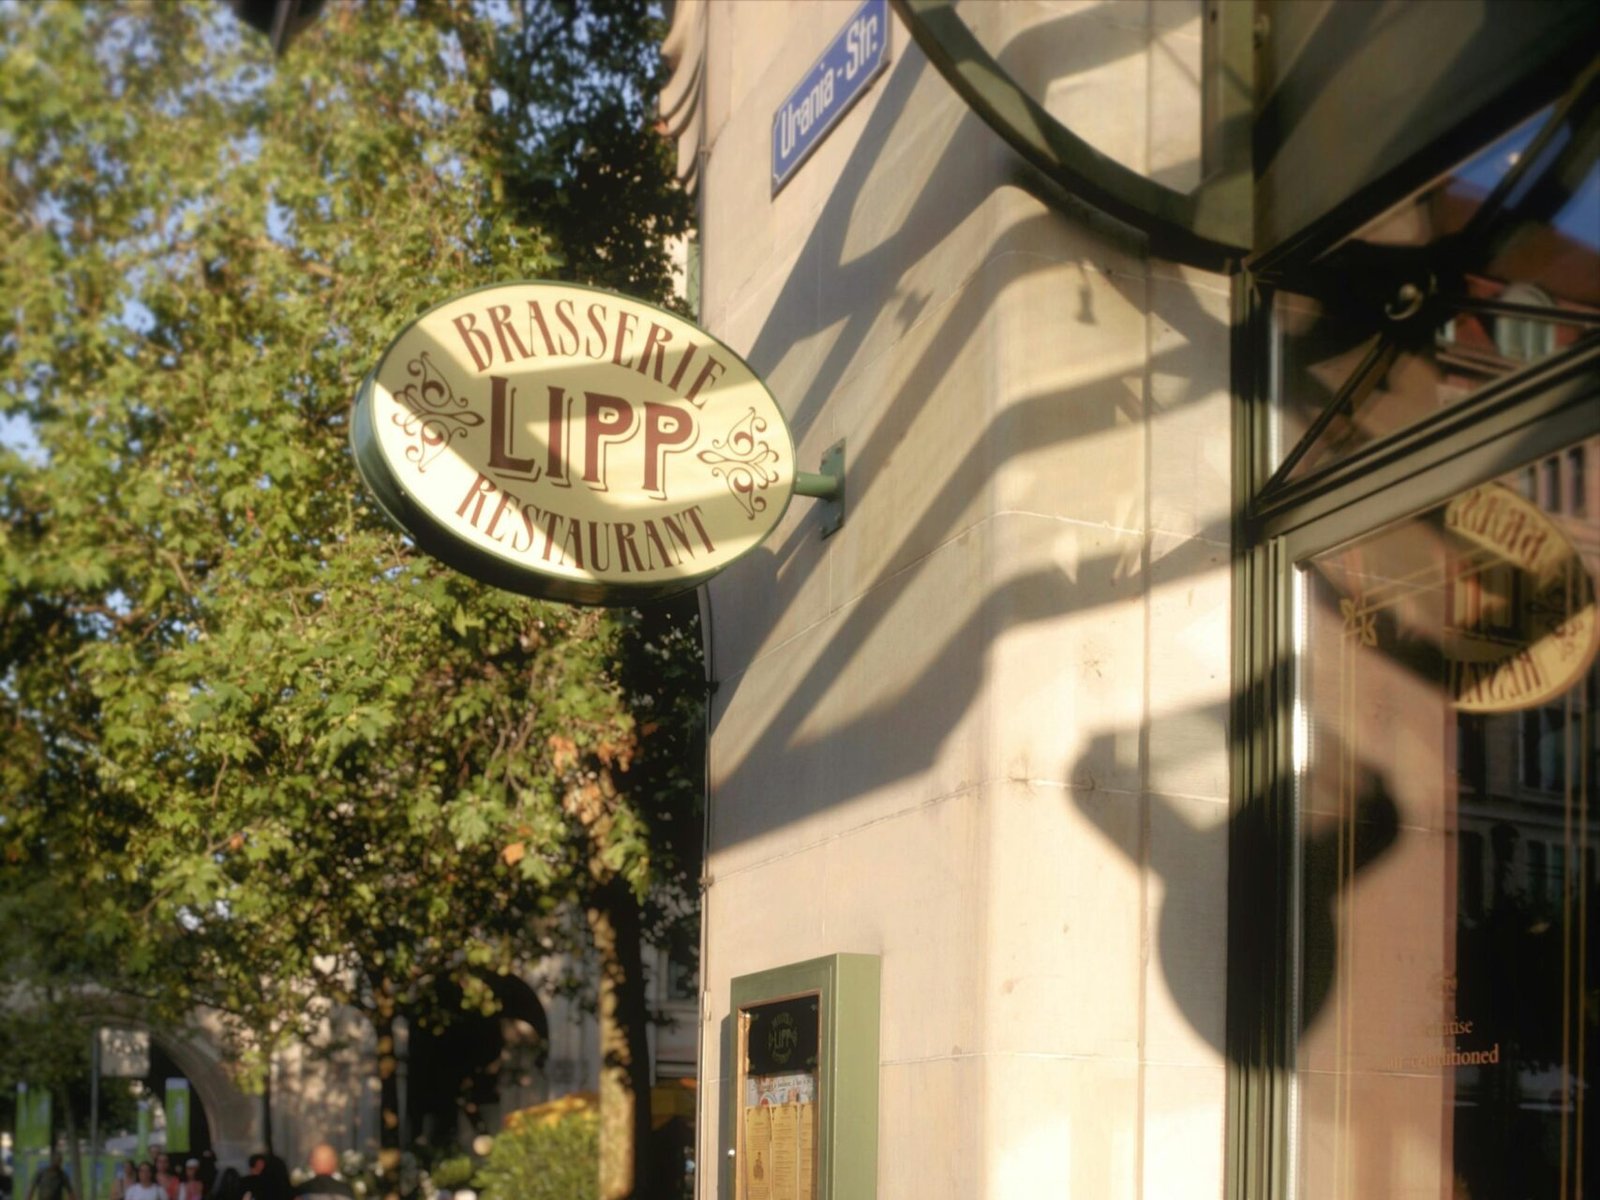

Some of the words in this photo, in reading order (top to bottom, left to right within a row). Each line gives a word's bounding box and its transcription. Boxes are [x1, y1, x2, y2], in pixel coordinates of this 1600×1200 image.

[452, 300, 727, 410] BRASSERIE
[486, 375, 700, 500] LIPP
[455, 471, 716, 573] RESTAURANT
